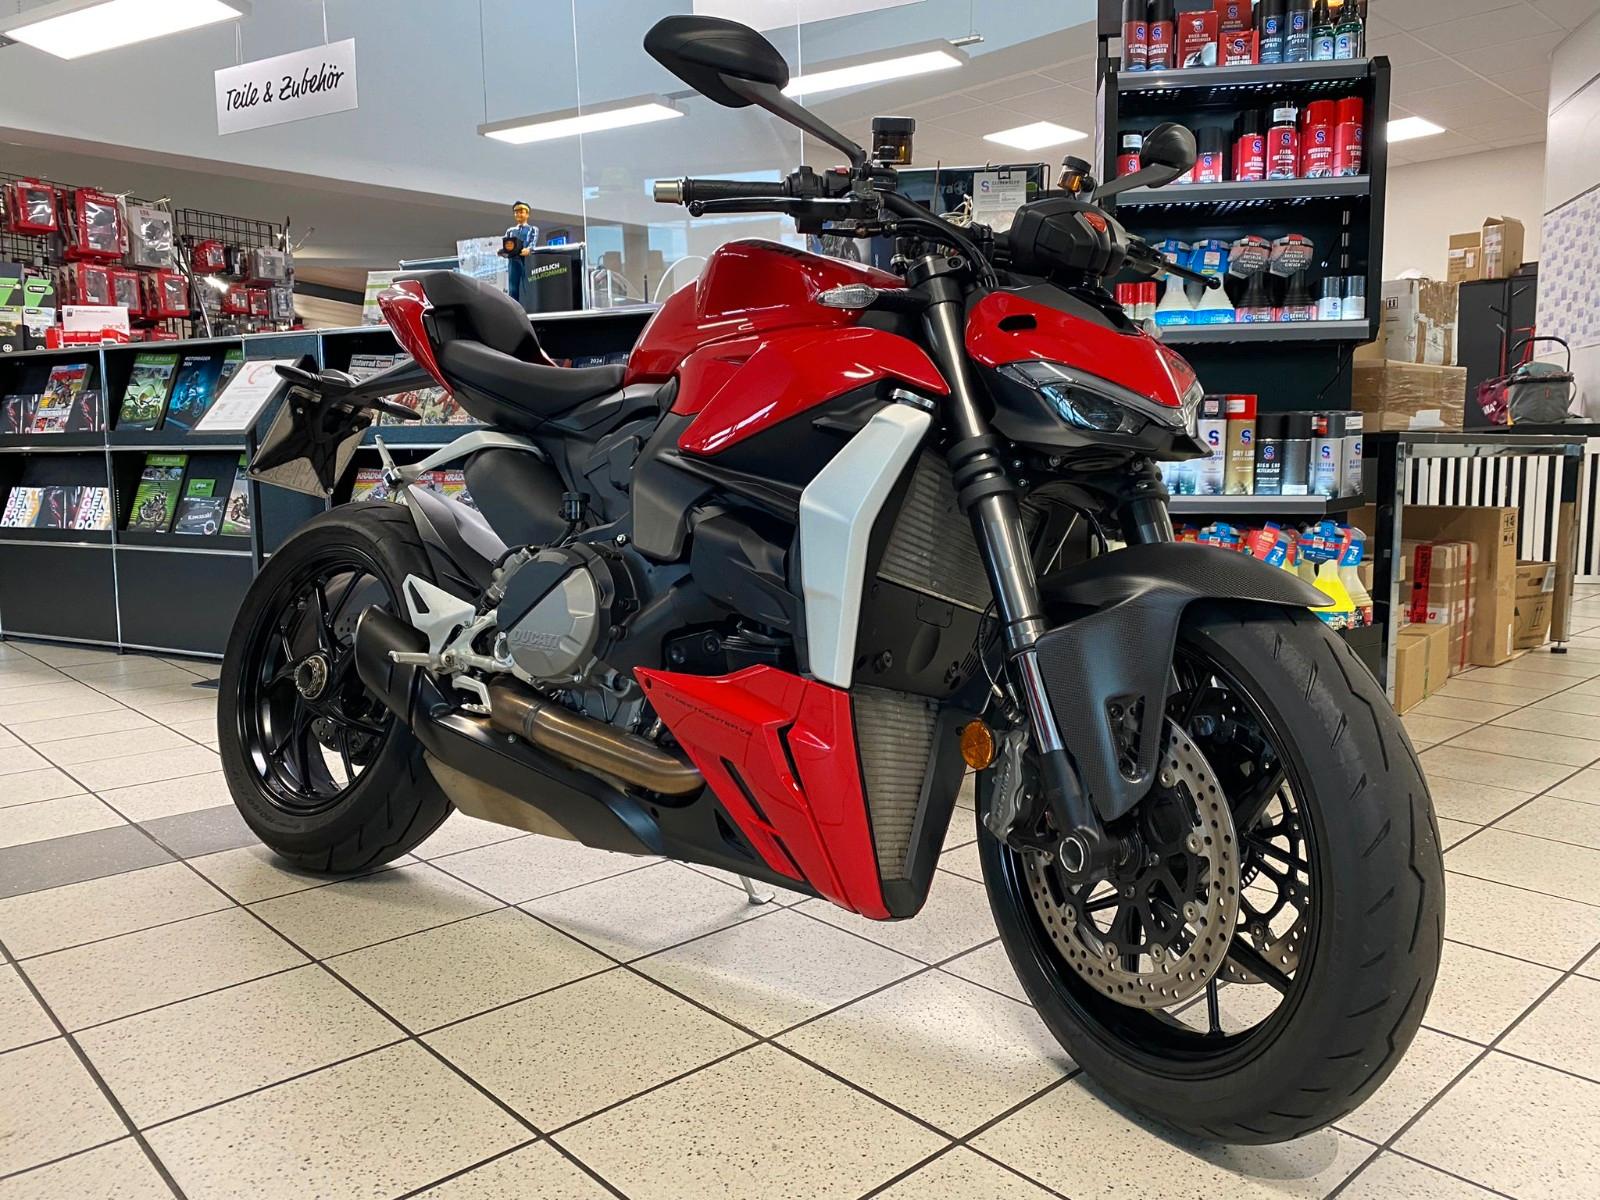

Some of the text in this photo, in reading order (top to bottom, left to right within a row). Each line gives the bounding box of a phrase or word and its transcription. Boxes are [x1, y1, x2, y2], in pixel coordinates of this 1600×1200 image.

[226, 63, 344, 111] Teile & Zubehör
[528, 267, 568, 282] WILLKOMMEN
[531, 262, 560, 276] HERZLICH
[188, 512, 212, 520] Kawasaki
[511, 630, 560, 650] DUCATI
